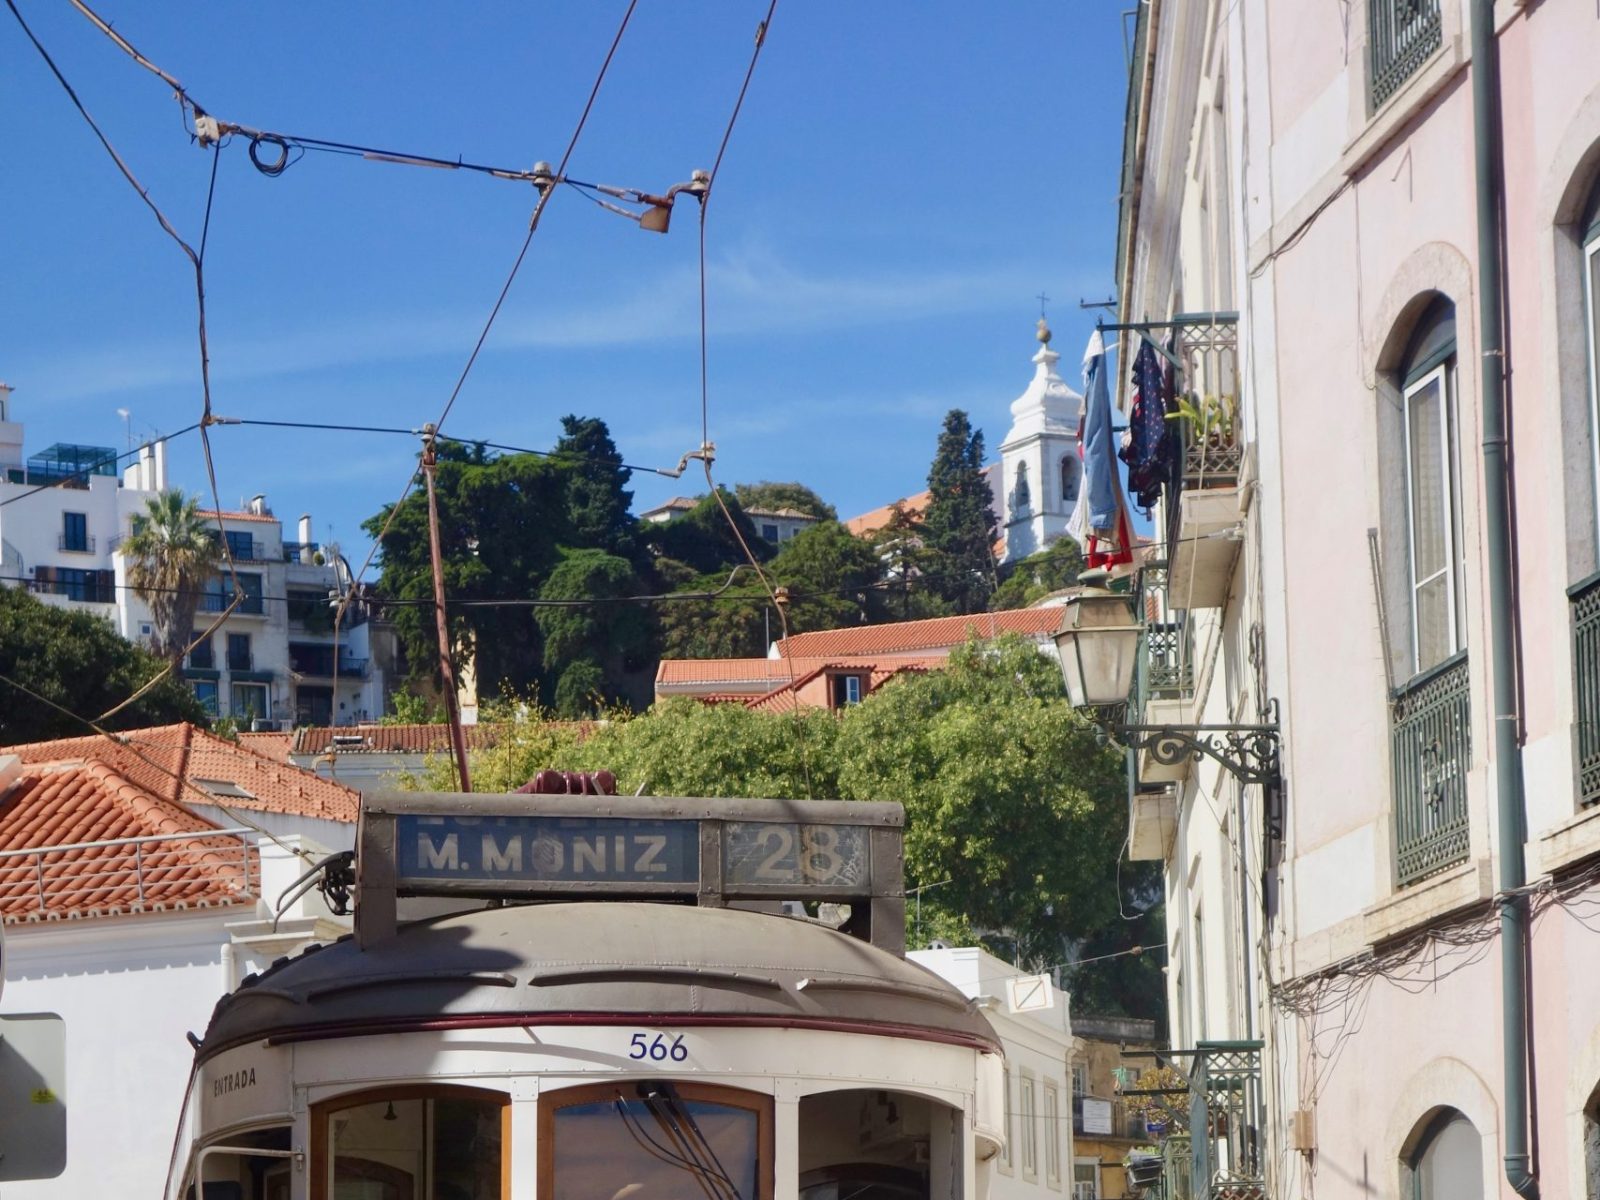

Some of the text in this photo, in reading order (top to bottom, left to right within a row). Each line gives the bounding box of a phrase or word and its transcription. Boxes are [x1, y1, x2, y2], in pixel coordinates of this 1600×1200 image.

[417, 832, 667, 873] M. MONIZ
[755, 825, 844, 882] 28
[629, 1033, 688, 1062] 566
[214, 1067, 256, 1098] ENTRADA
